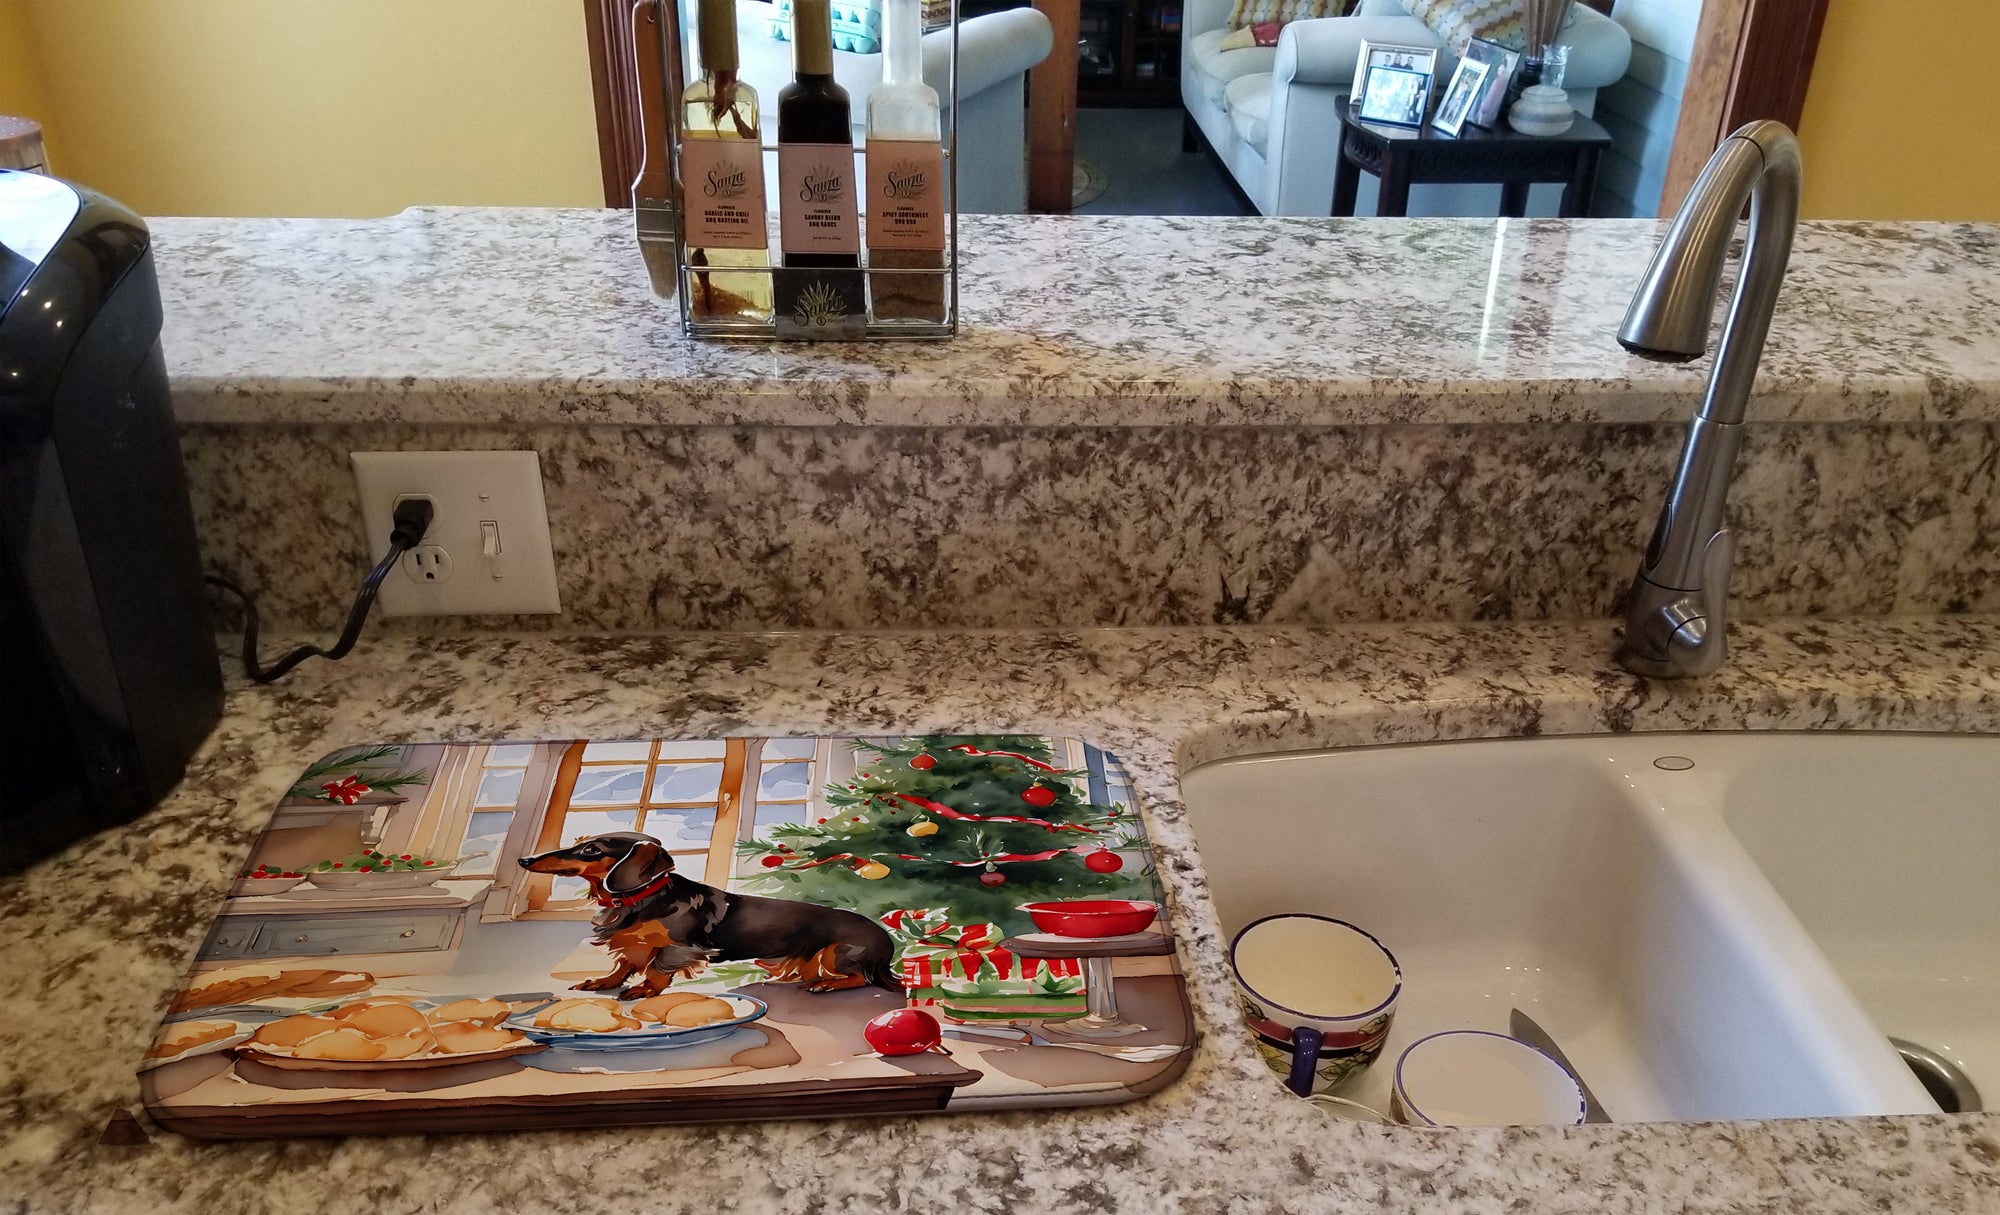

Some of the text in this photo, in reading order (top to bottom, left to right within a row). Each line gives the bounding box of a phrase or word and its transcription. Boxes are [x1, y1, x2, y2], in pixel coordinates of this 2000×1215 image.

[704, 169, 745, 198] Sauza
[800, 175, 841, 202] Sauza
[884, 171, 925, 198] Sauza
